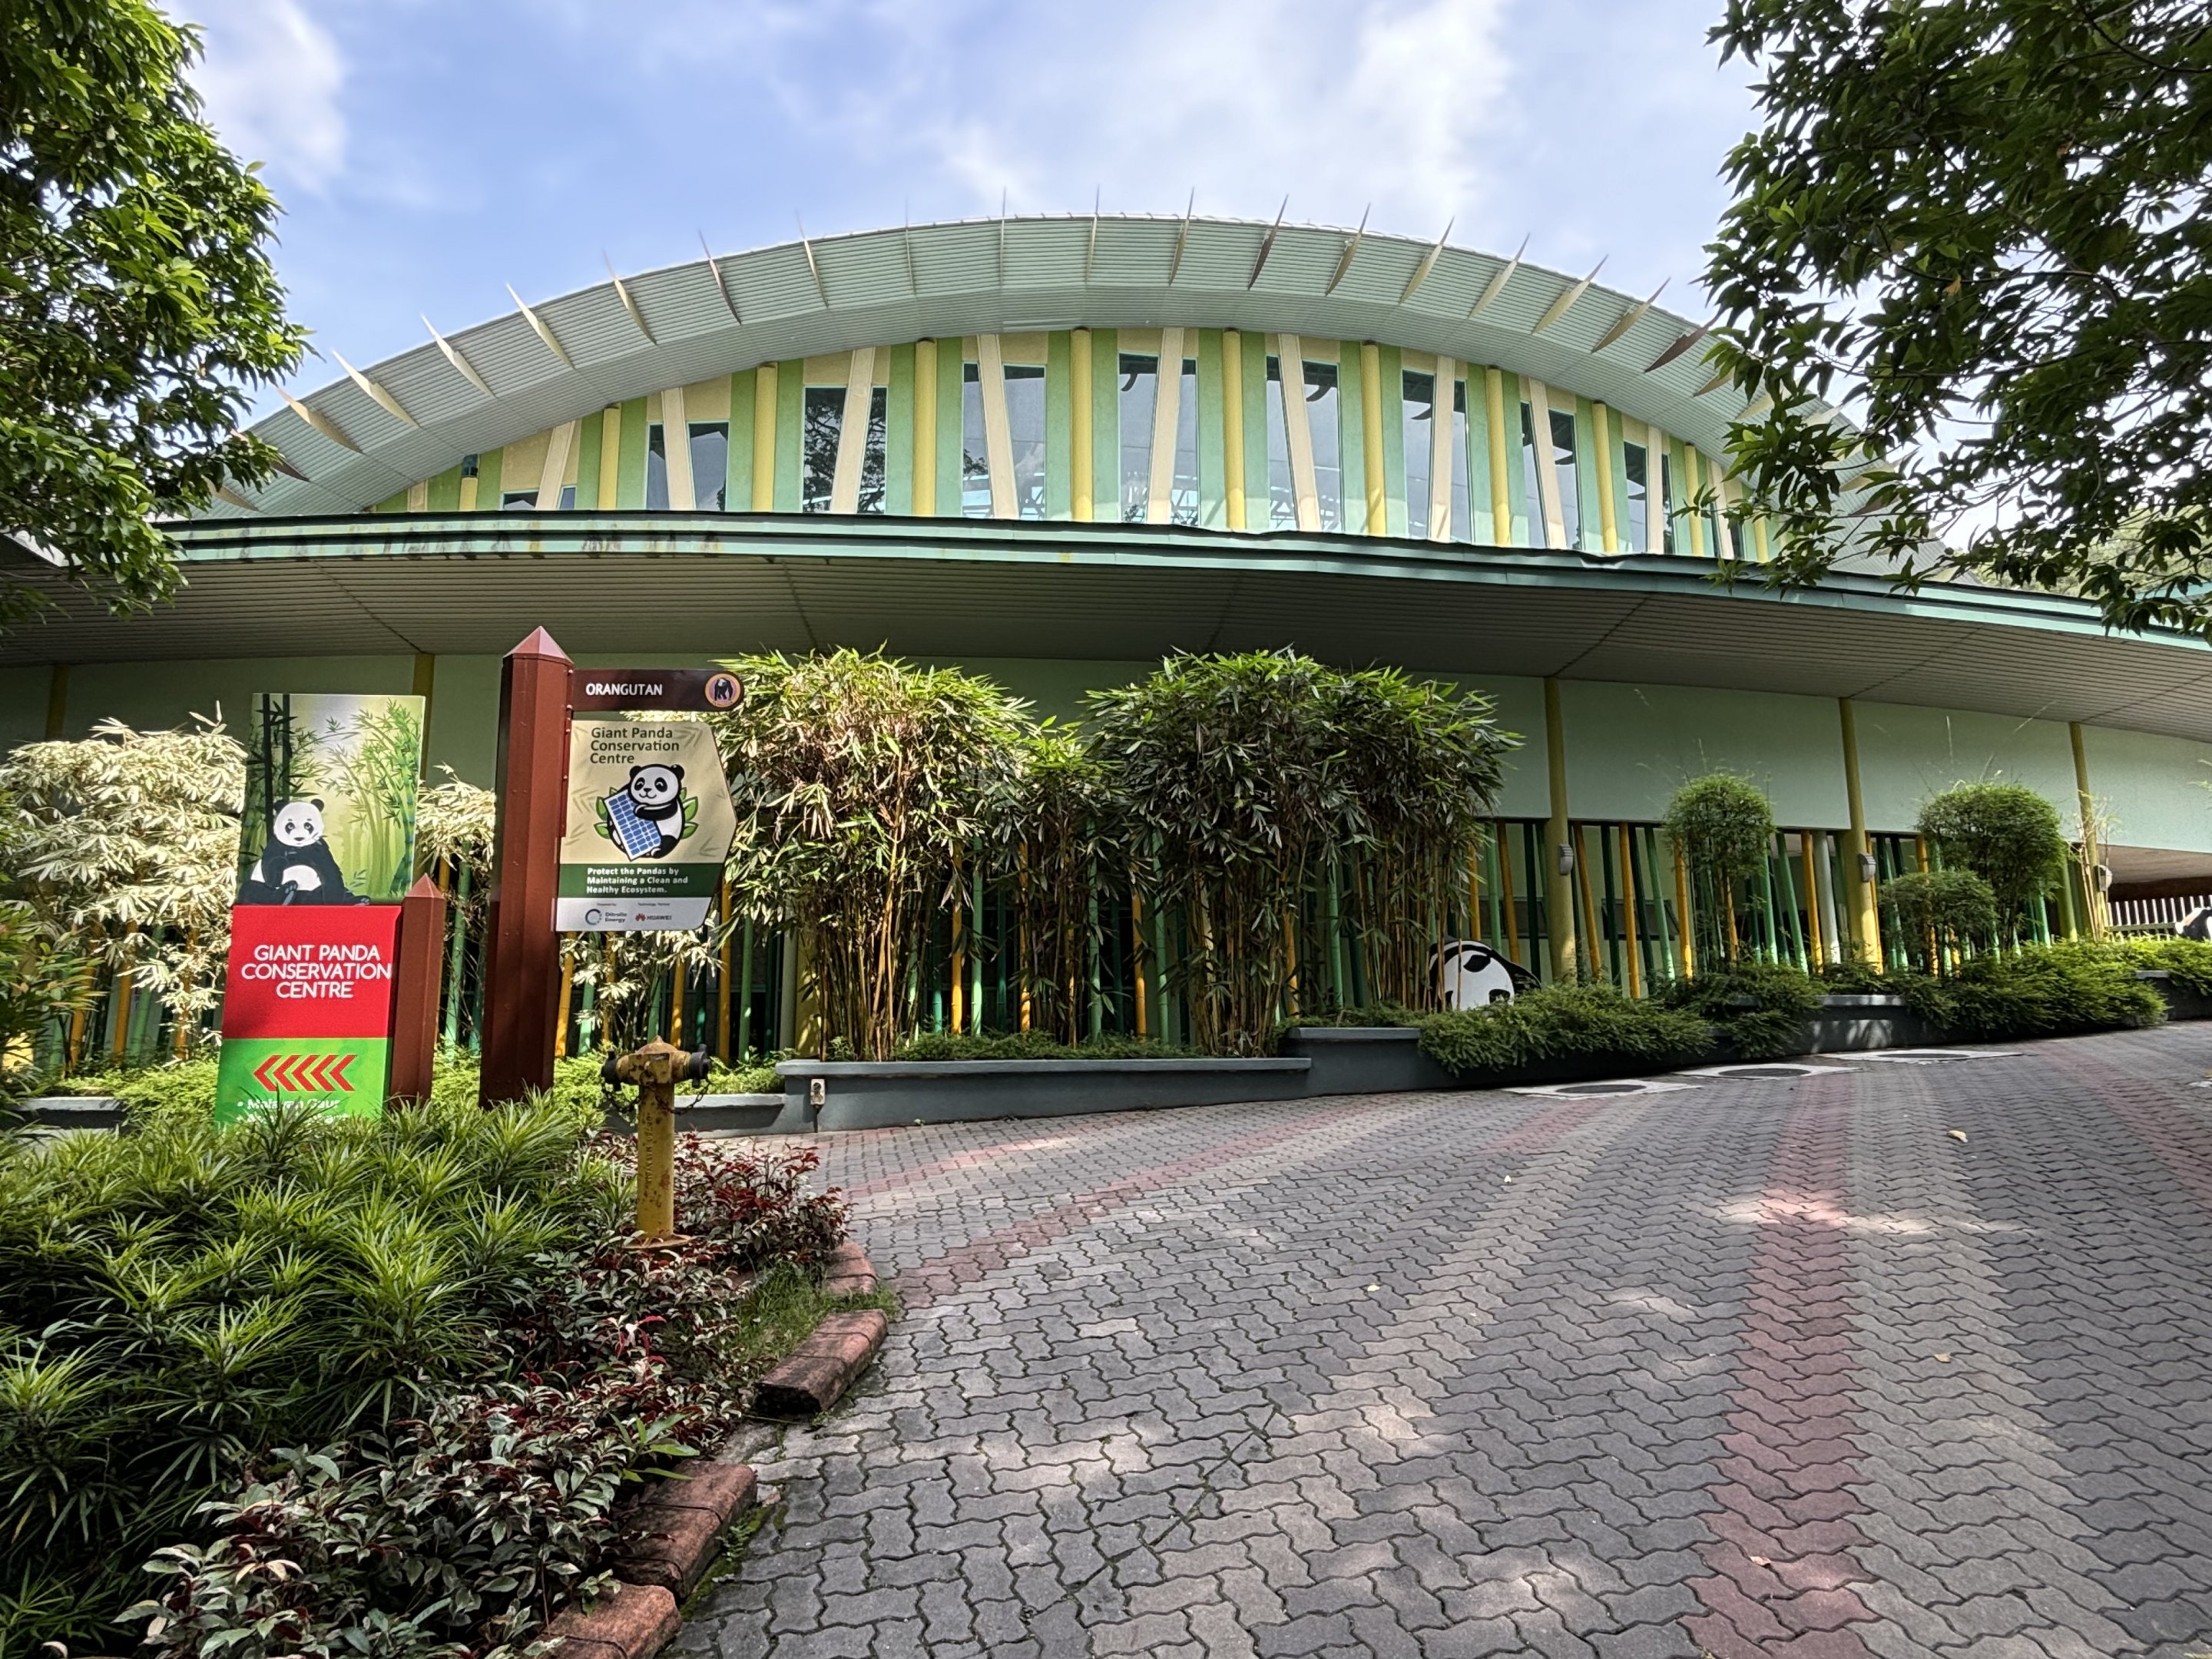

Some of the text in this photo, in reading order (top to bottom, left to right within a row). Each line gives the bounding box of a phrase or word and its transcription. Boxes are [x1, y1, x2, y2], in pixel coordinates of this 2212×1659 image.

[585, 683, 663, 696] ORANGUTAN
[591, 727, 673, 738] Giant Panda
[591, 740, 680, 751] Conservation
[590, 753, 635, 763] Centre
[669, 867, 679, 876] by
[587, 876, 637, 885] Maintaining
[587, 886, 667, 894] Healthy Ecosystem.
[254, 945, 381, 961] GIANT PANDA
[241, 962, 392, 980] CONSERVATION
[276, 981, 354, 998] CENTRE
[247, 1098, 303, 1109] Malaan
